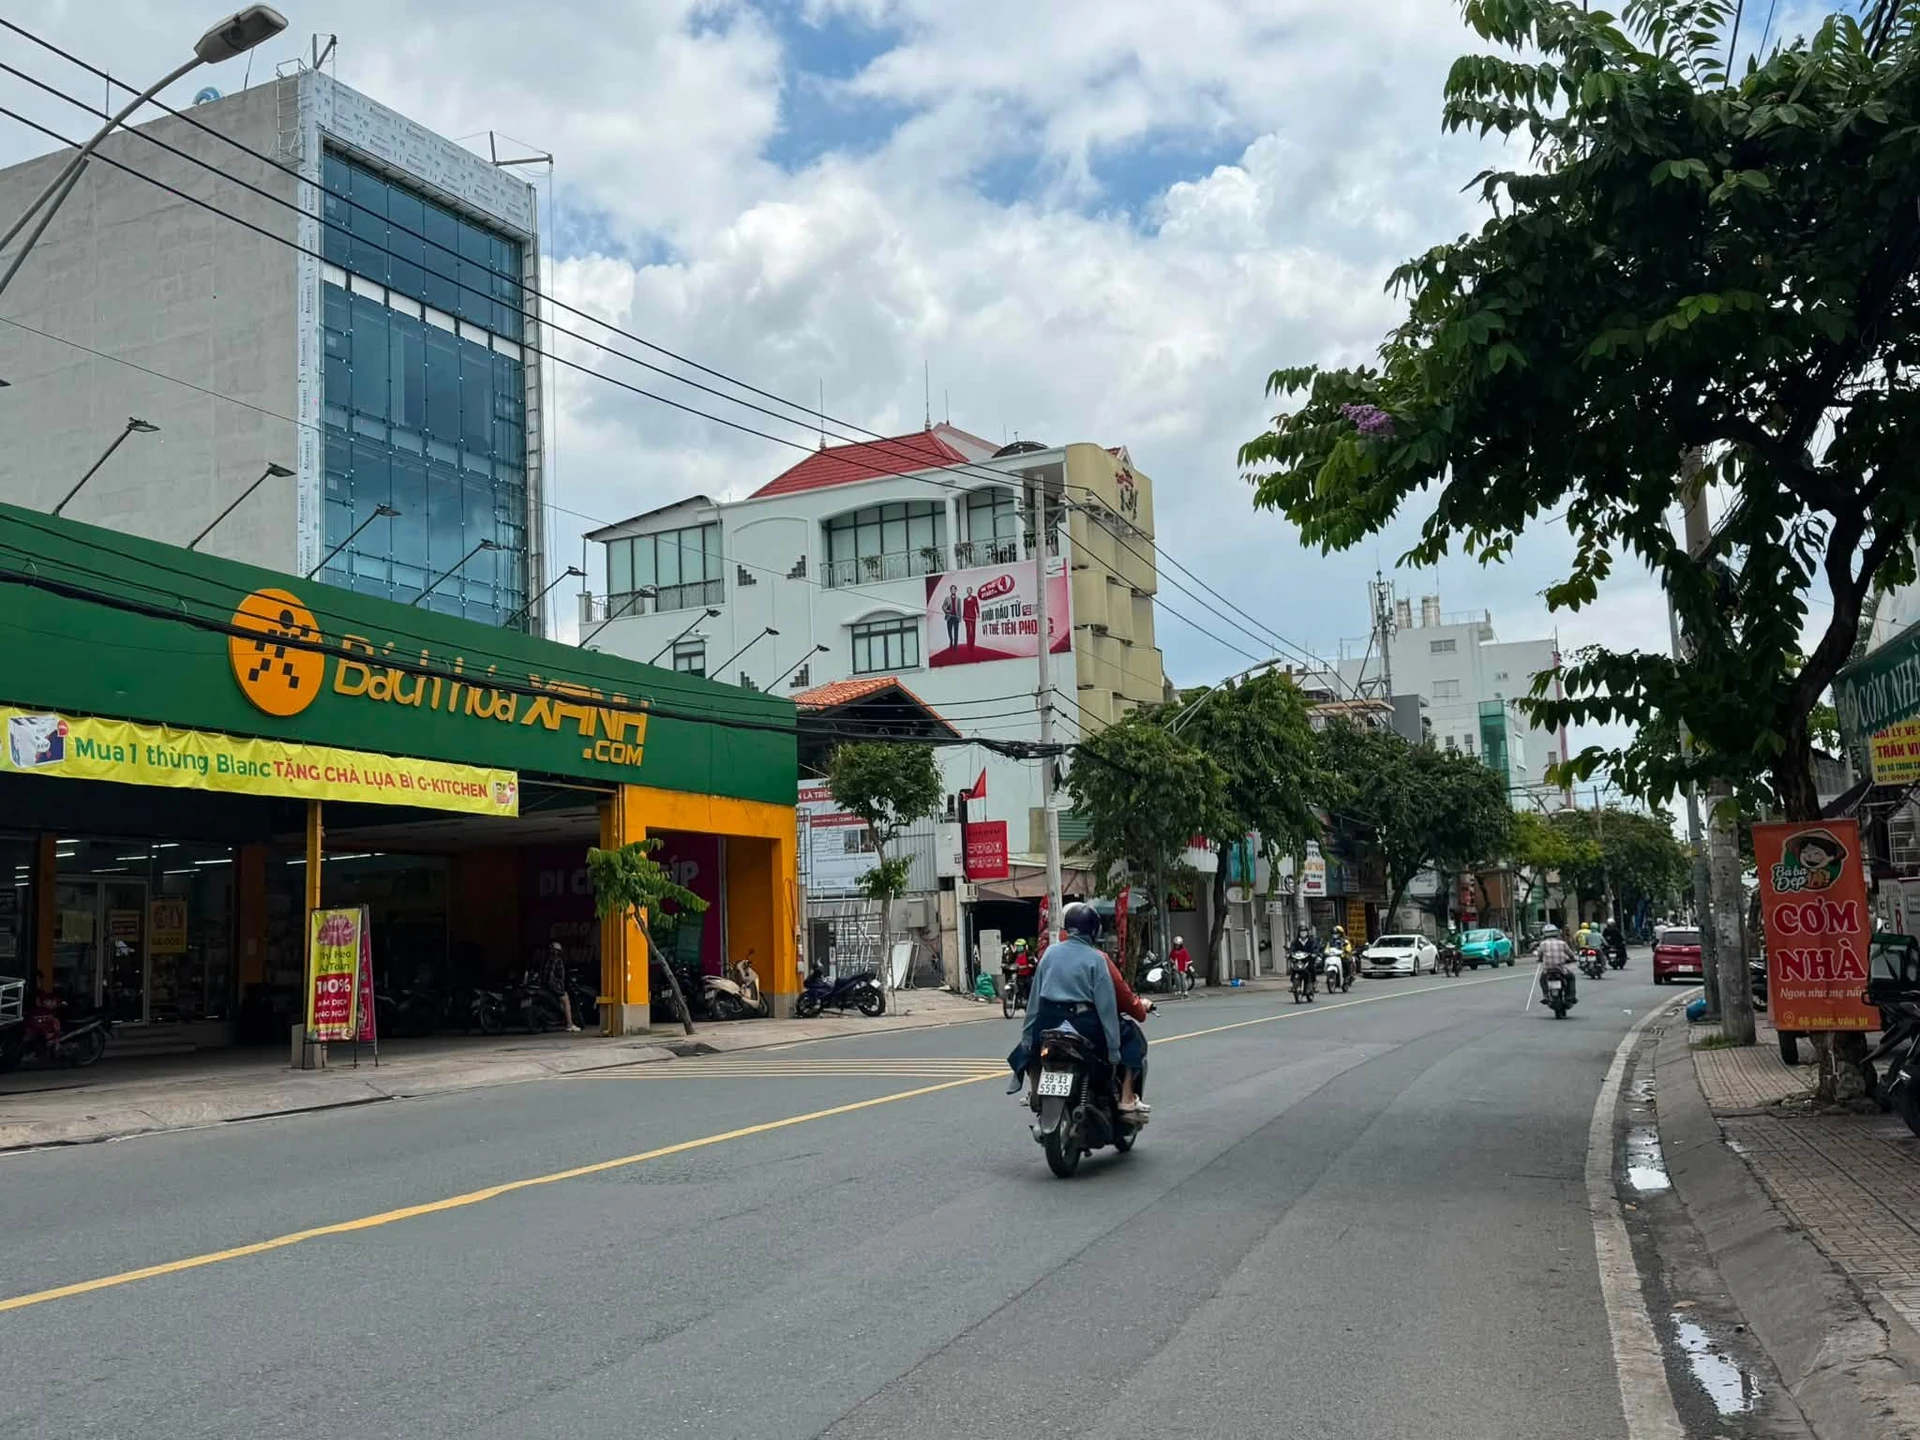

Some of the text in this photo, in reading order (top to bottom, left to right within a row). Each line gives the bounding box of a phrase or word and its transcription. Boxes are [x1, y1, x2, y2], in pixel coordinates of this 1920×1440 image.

[1019, 617, 1054, 635] PHOG
[333, 634, 442, 711] Bách
[447, 656, 518, 723] hóa
[75, 737, 125, 762] Mua
[129, 743, 138, 764] 1
[146, 745, 210, 776] thùng
[217, 754, 271, 778] Blanc
[273, 758, 320, 783] TẶNG
[364, 770, 395, 791] LỤA
[399, 773, 414, 789] BÌ
[418, 776, 488, 798] G-KITCHEN
[582, 740, 644, 767] .COM
[1773, 896, 1860, 936] CƠM
[1776, 938, 1868, 982] NHÀ
